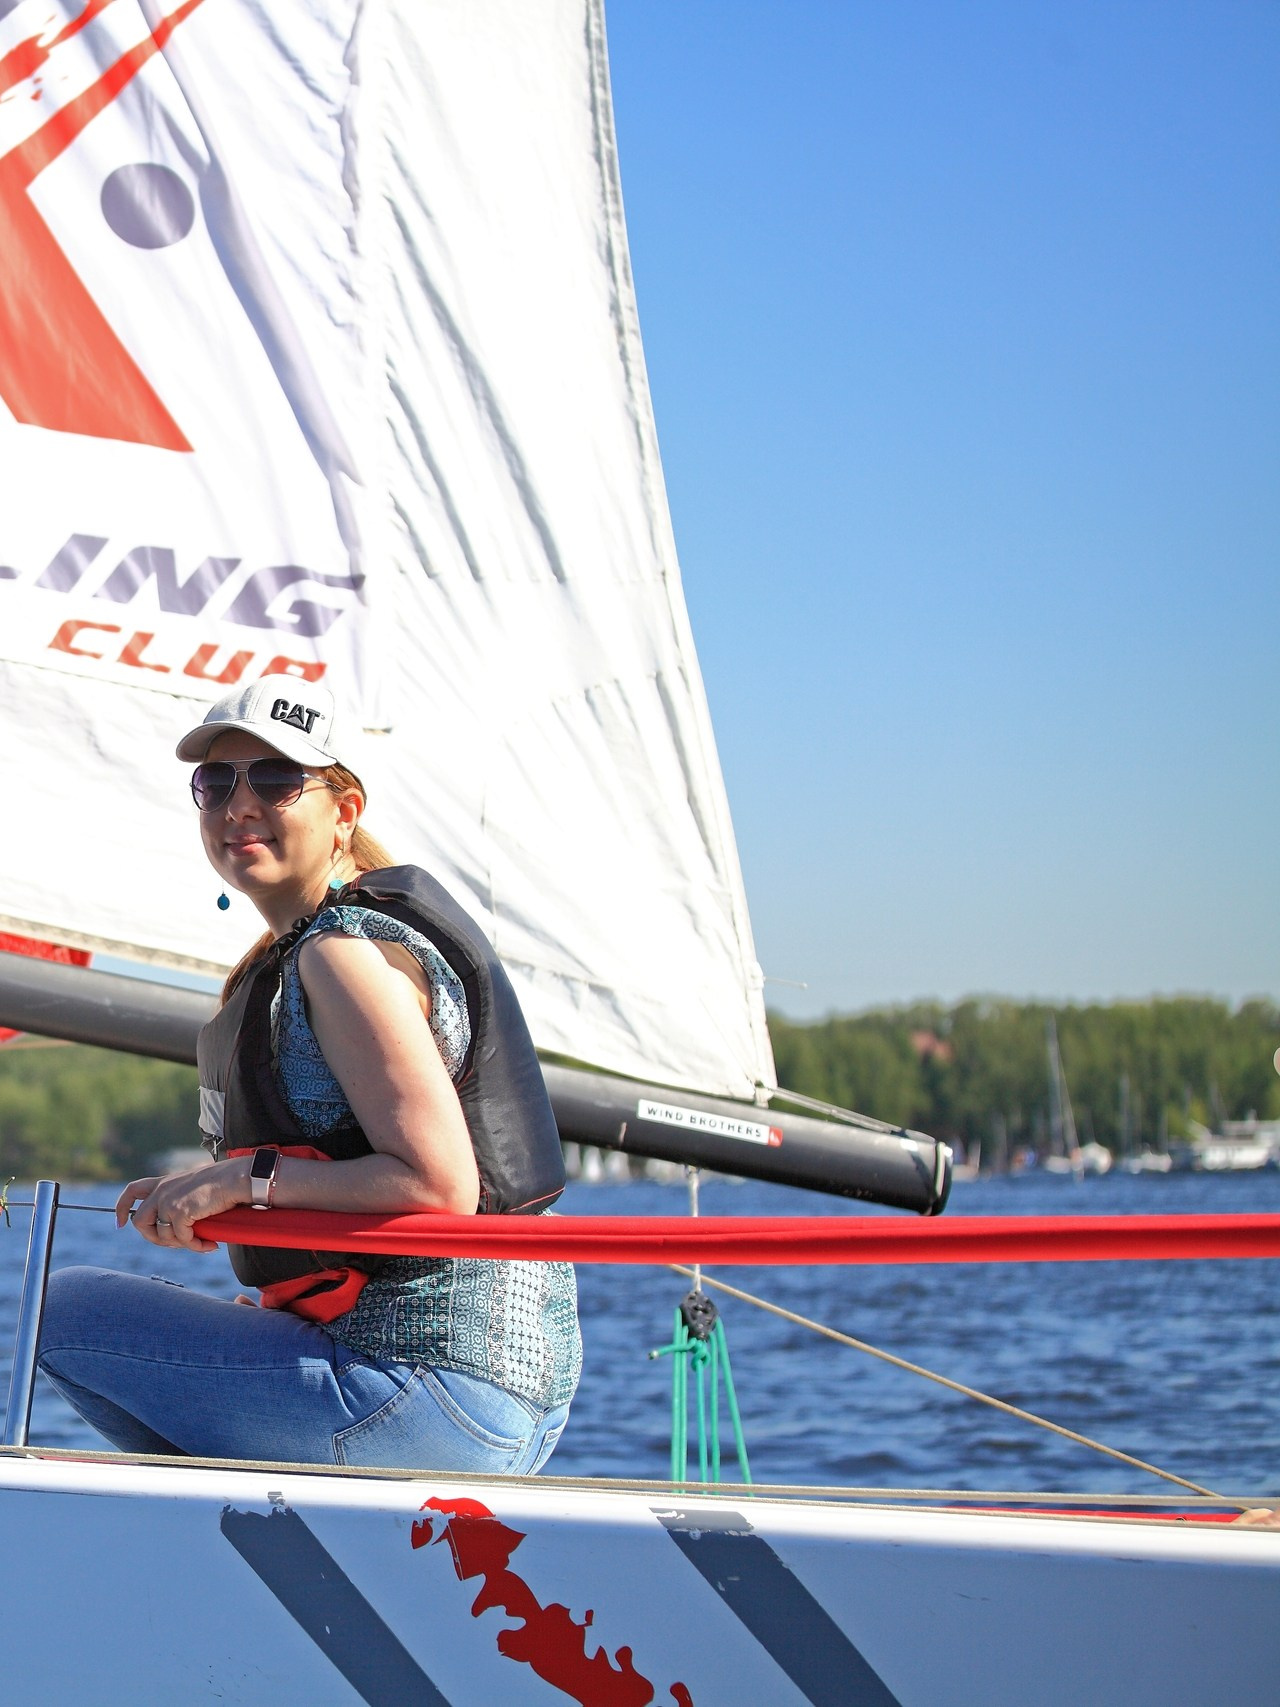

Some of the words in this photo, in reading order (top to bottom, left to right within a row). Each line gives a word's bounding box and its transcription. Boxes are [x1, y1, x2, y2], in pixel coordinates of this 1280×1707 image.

[270, 698, 320, 734] CAT
[647, 1106, 683, 1121] WIND
[689, 1115, 762, 1138] BROTHERS
